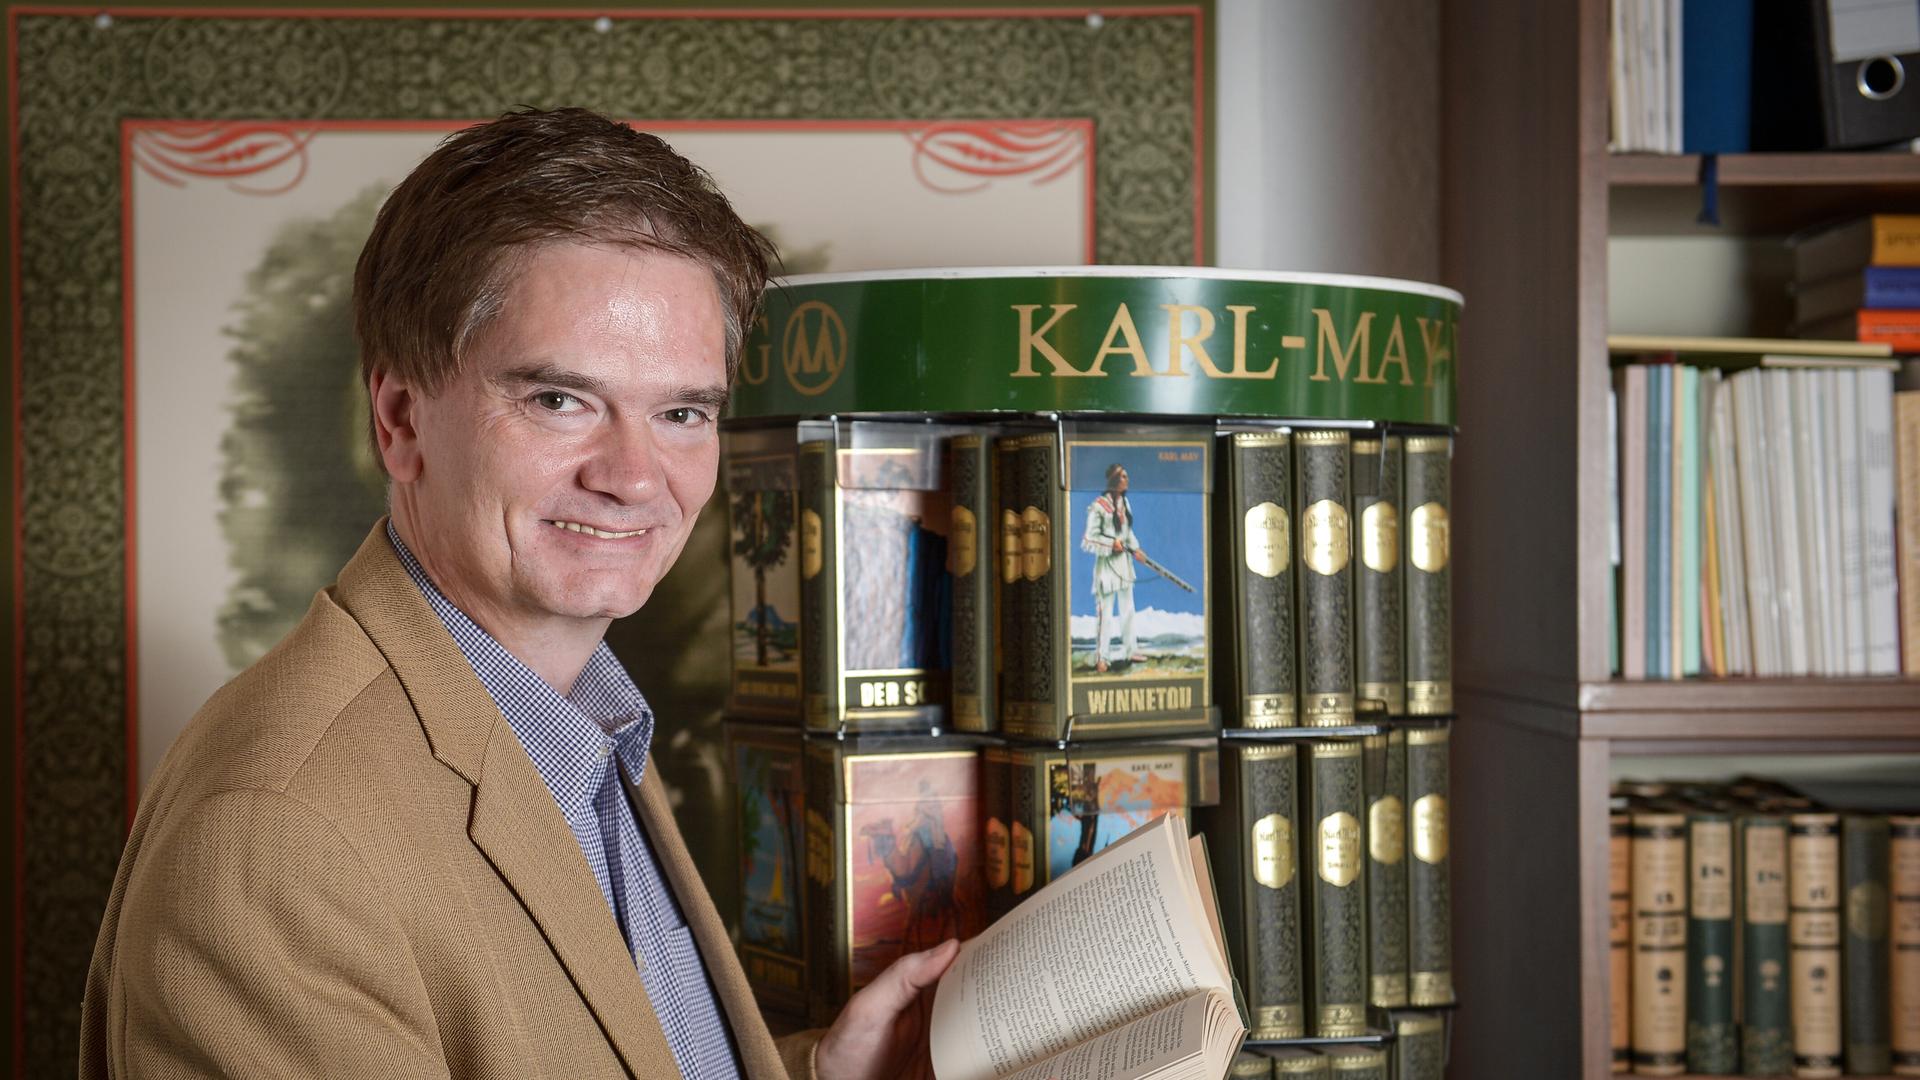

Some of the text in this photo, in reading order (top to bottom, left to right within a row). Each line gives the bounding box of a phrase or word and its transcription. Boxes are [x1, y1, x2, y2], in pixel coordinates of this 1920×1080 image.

[1009, 302, 1458, 388] KARL-MAY-
[860, 682, 899, 707] DER
[1087, 686, 1192, 714] WINNETOU
